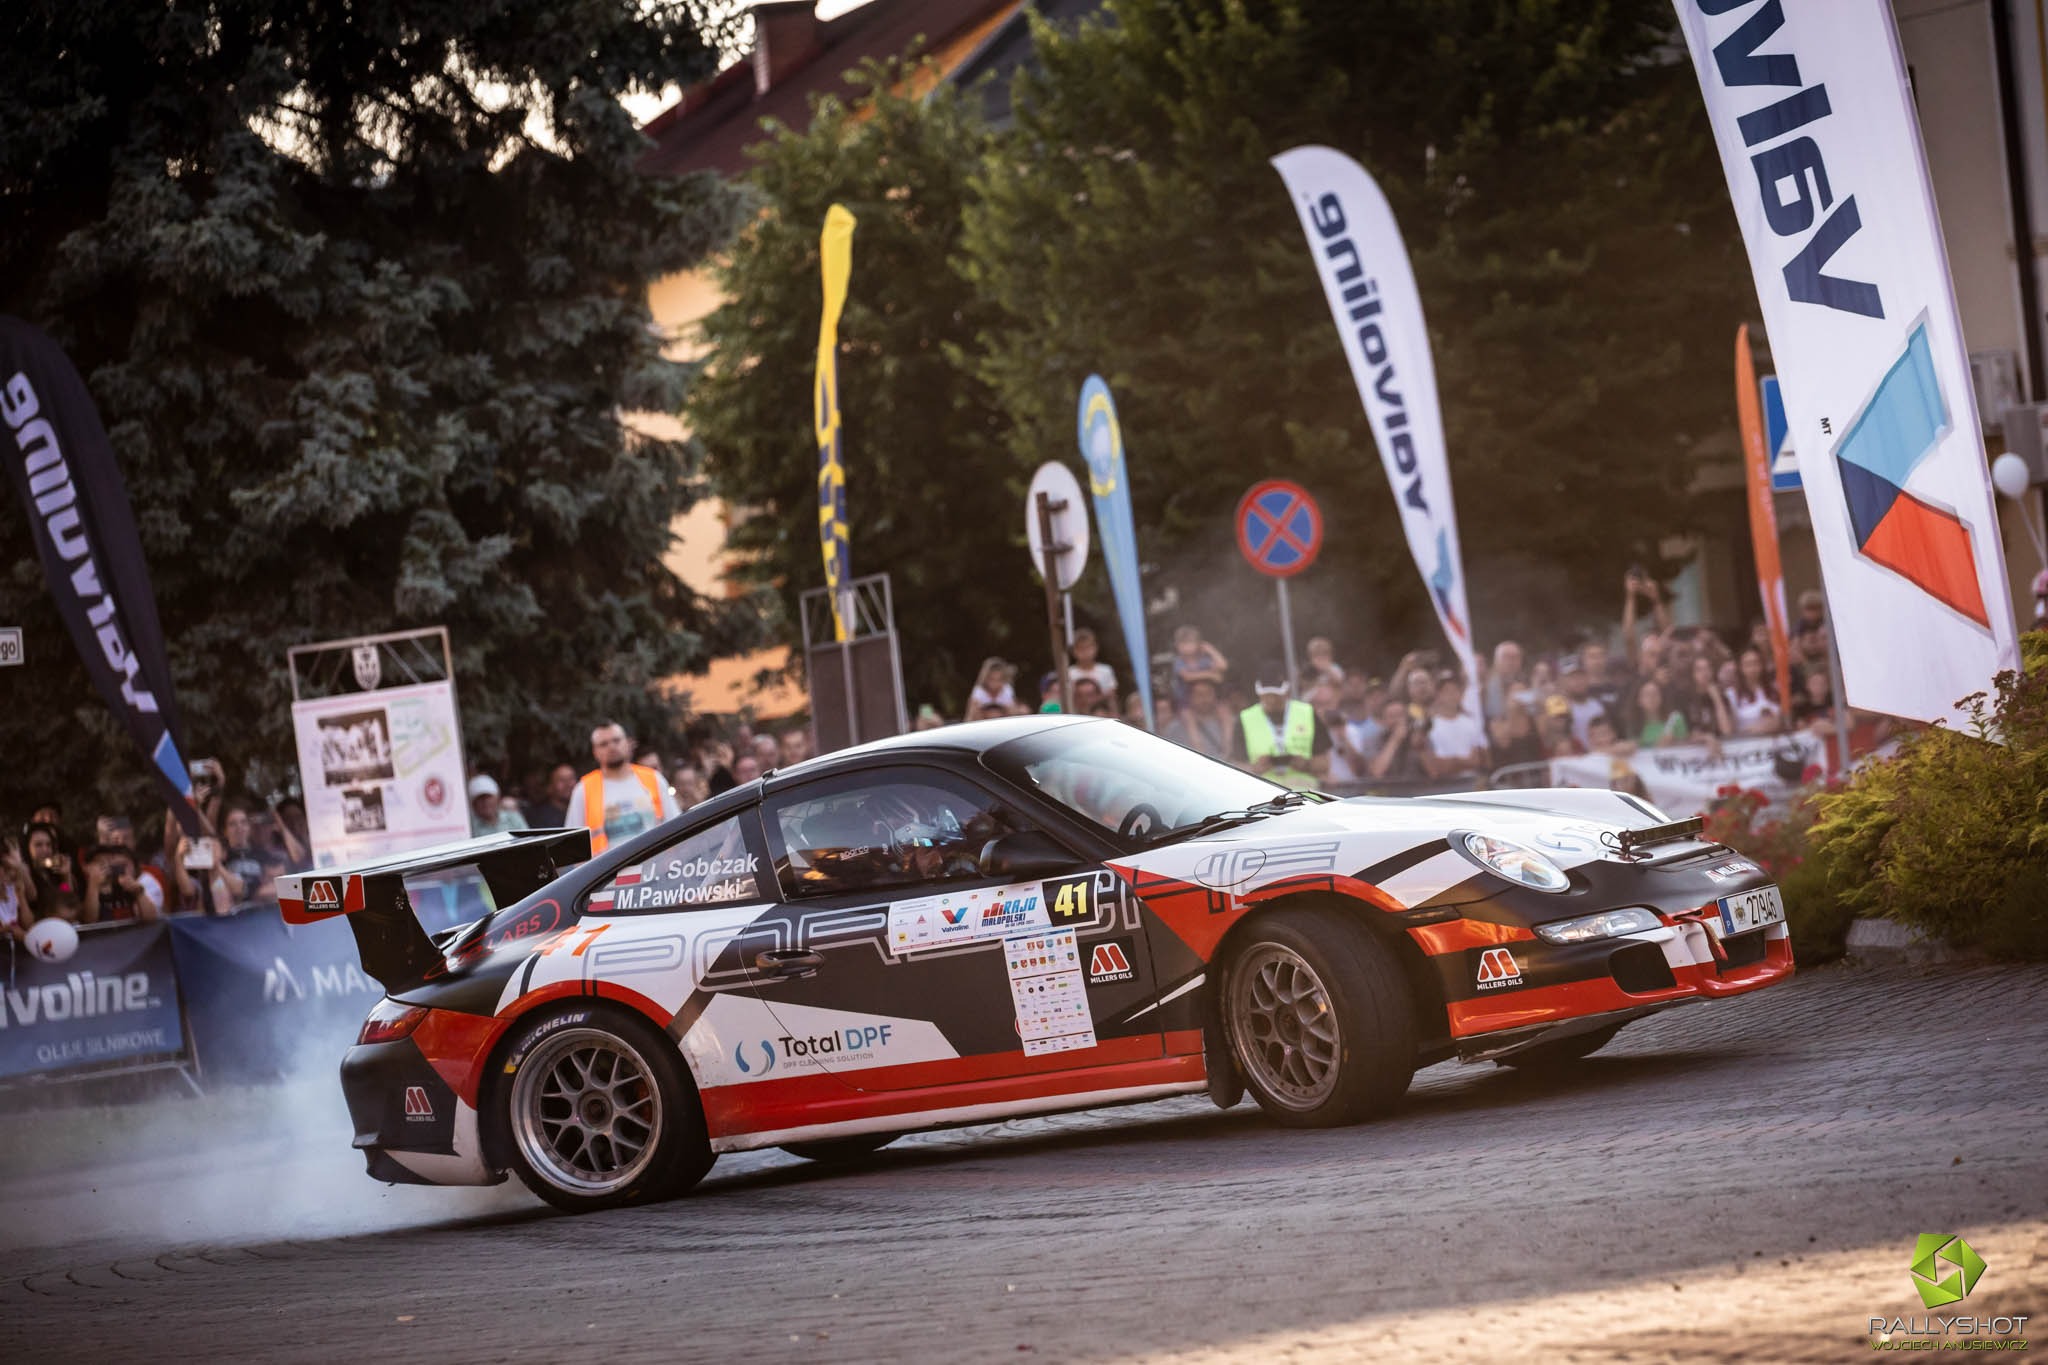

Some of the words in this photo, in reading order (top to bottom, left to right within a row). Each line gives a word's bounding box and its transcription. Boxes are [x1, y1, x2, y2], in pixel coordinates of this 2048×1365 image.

[643, 867, 660, 882] J.
[667, 853, 760, 879] Sobczak
[1054, 881, 1088, 917] 41
[1746, 891, 1777, 925] 27946
[941, 924, 970, 933] Valvoline
[1090, 973, 1117, 984] MILLERS
[1118, 971, 1133, 980] OILS
[1477, 981, 1507, 990] MILLERS
[1507, 978, 1523, 986] OILS
[778, 1030, 842, 1057] Total
[845, 1024, 892, 1050] DPF
[800, 1057, 835, 1067] CLEANING
[837, 1053, 874, 1063] SOLUTION
